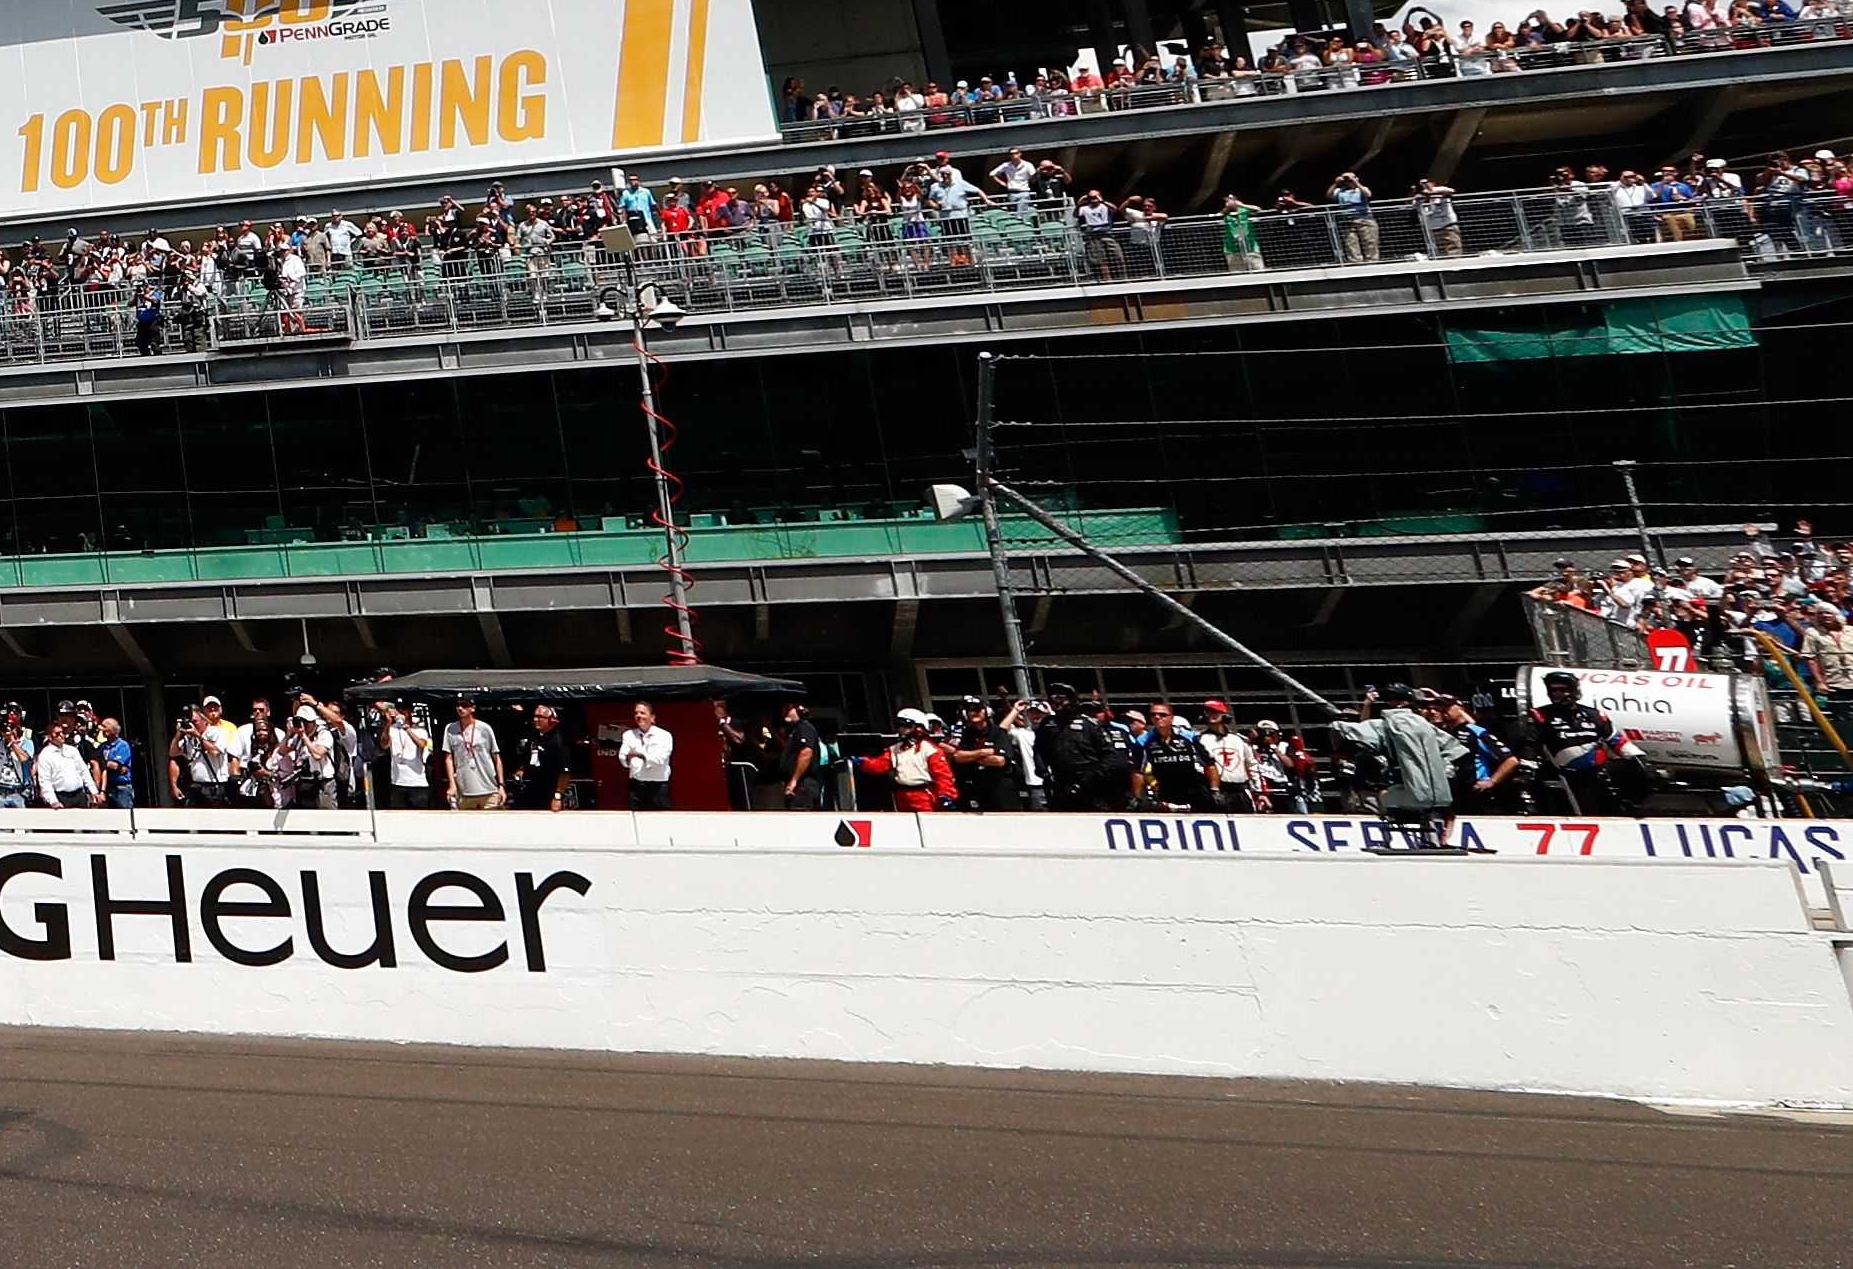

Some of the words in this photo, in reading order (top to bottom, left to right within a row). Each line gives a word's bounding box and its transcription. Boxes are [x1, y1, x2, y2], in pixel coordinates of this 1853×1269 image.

[197, 49, 548, 175] RUNNING
[1655, 647, 1689, 671] 77
[1661, 676, 1713, 689] OIL
[1516, 823, 1600, 855] 77
